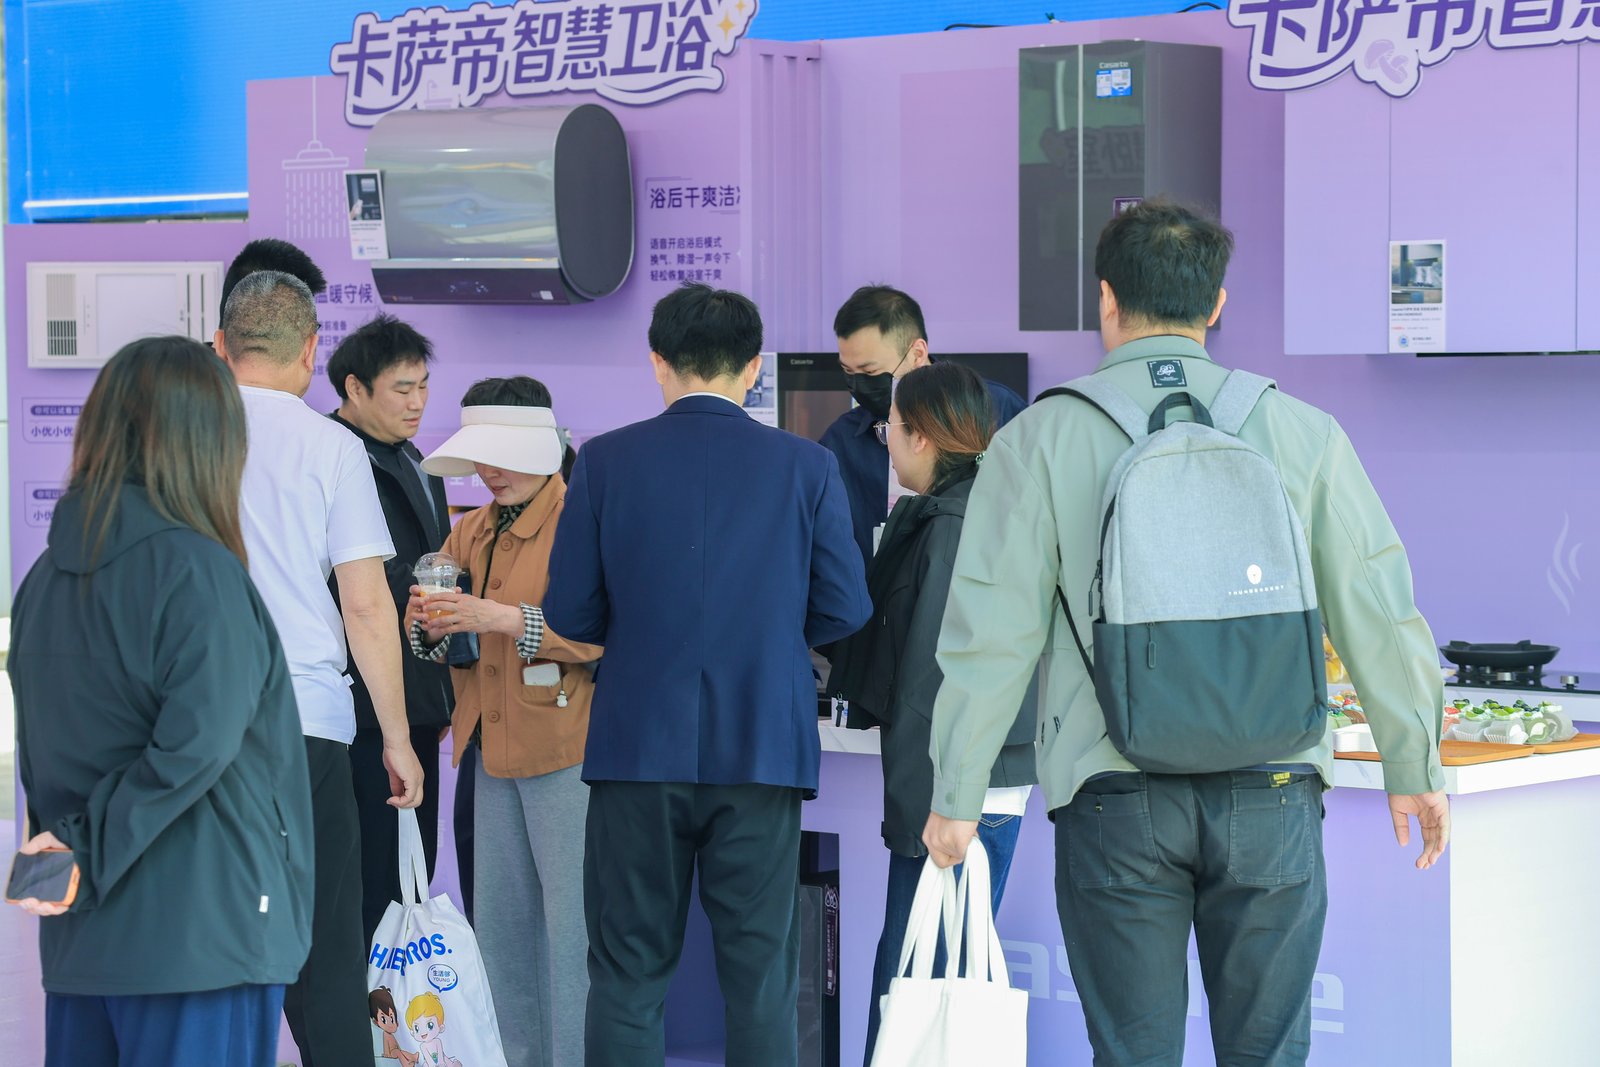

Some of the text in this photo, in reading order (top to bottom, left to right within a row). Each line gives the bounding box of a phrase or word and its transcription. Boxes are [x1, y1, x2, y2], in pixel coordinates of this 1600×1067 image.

[338, 0, 713, 114] 卡萨帝智慧卫浴
[650, 185, 740, 209] 浴后干爽洁
[650, 236, 722, 250] 语音开启浴后模式
